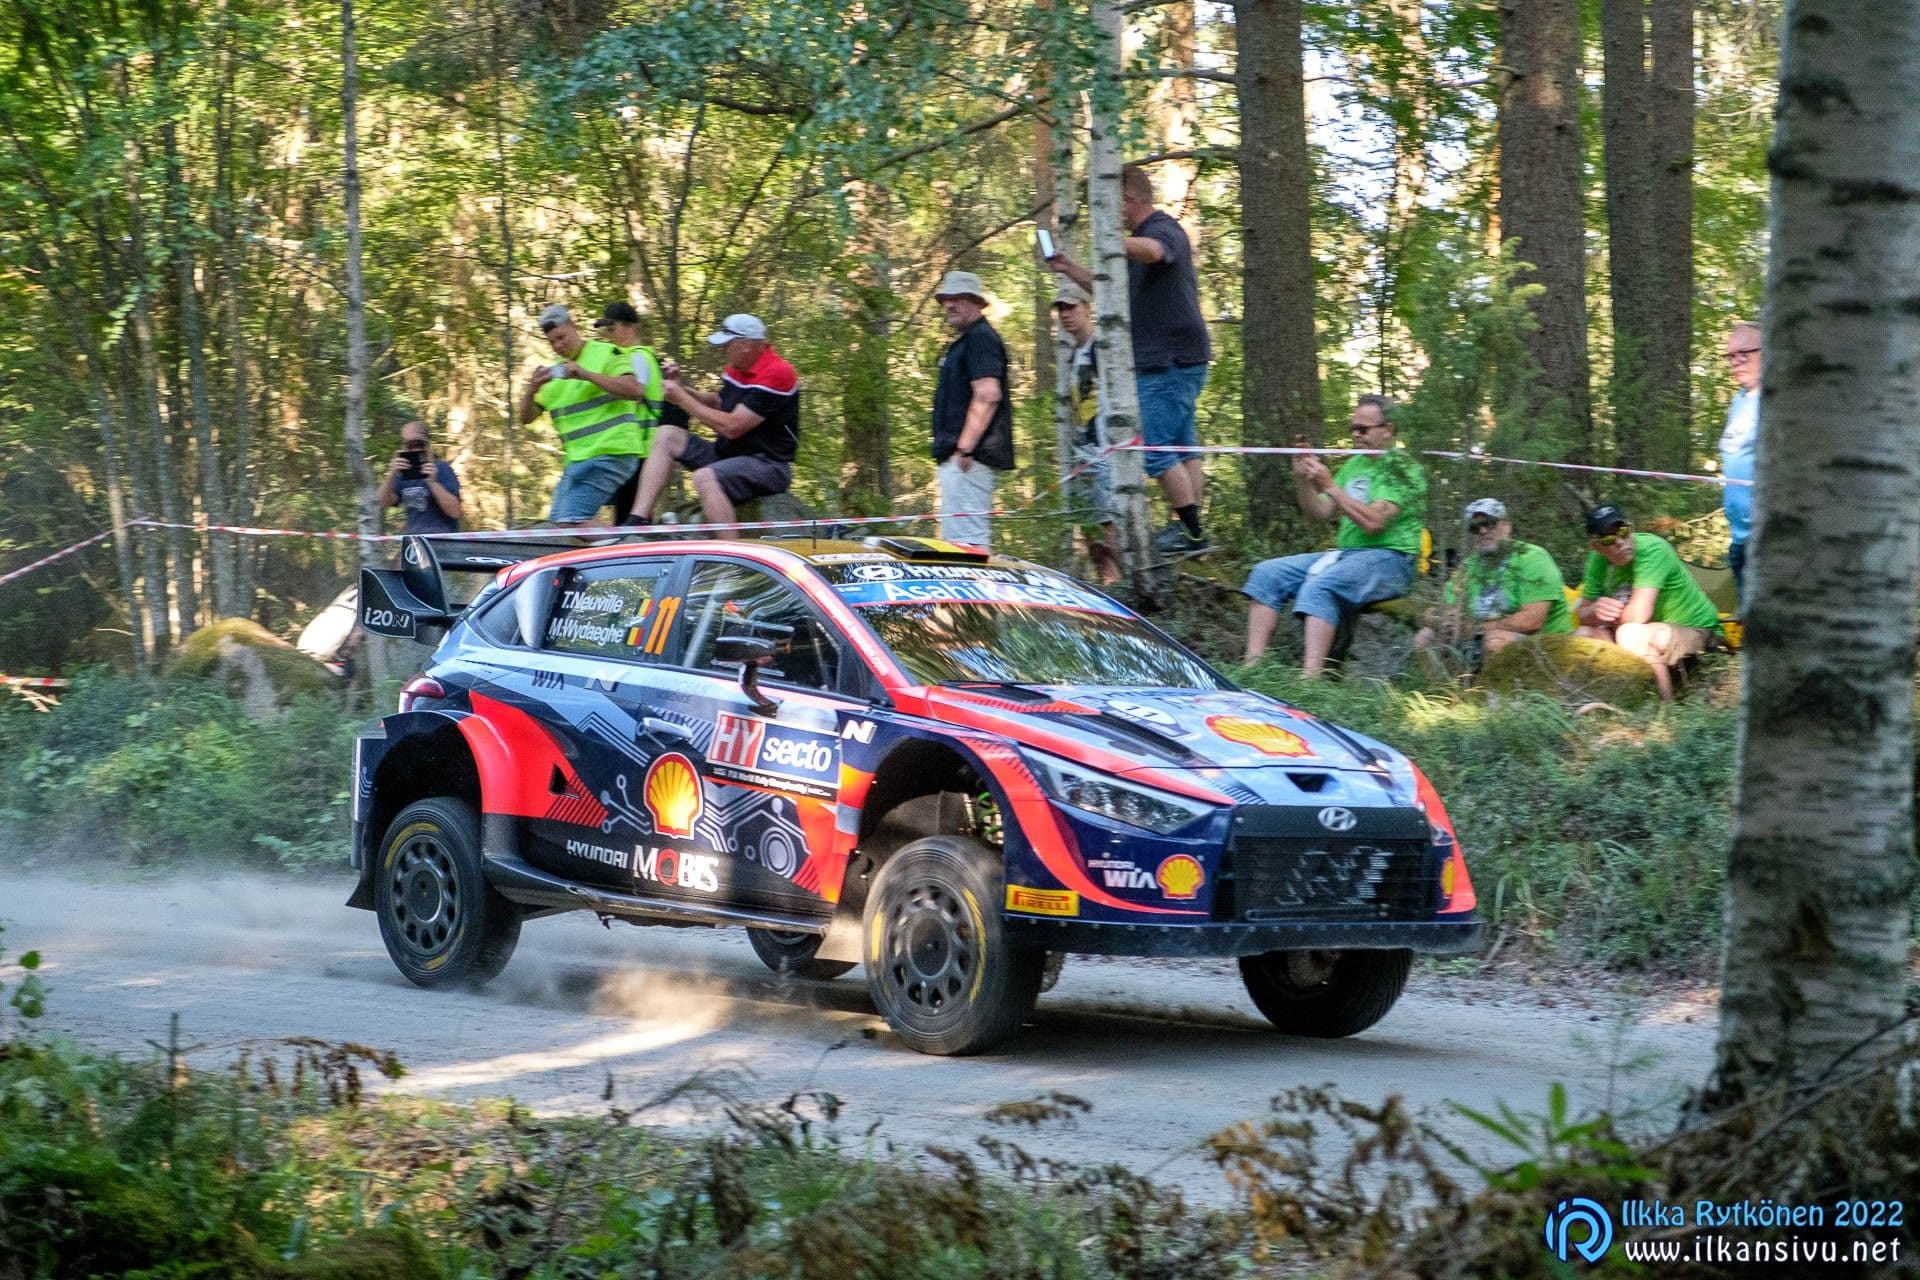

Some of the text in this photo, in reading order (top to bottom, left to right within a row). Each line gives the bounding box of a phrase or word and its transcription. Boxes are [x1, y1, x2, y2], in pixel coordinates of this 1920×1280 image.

[562, 591, 624, 613] T.Neuville
[548, 617, 624, 646] M.Wydaeghe
[644, 596, 681, 655] 11
[532, 670, 565, 690] WIA
[711, 715, 832, 772] HY secto
[840, 719, 878, 744] N
[566, 839, 720, 893] HYUNDAI MOBIS
[1103, 868, 1158, 889] WIA
[1013, 890, 1070, 911] PIRELLI
